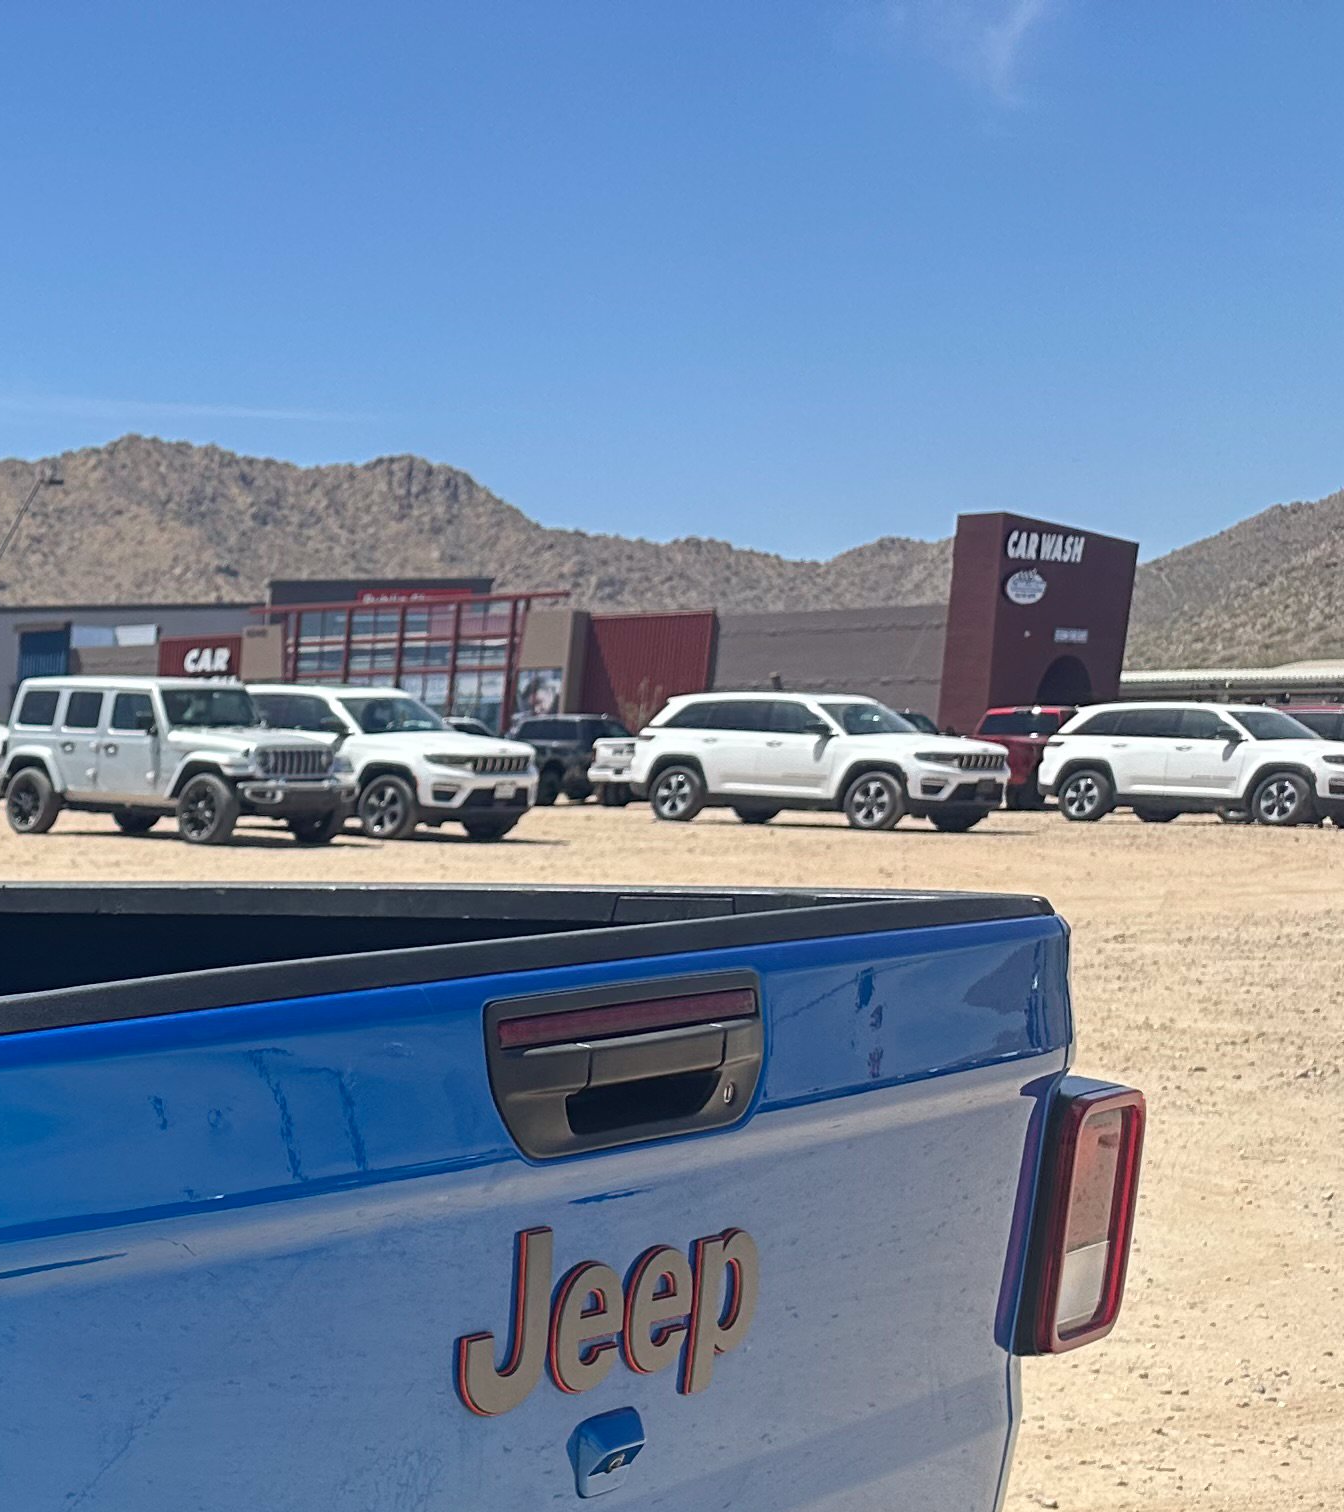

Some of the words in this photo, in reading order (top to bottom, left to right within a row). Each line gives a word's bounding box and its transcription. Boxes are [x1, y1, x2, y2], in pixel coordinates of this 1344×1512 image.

[1007, 529, 1039, 560] CAR
[1039, 532, 1085, 563] WASH
[183, 646, 231, 673] CAR
[458, 1226, 759, 1417] Jeep
